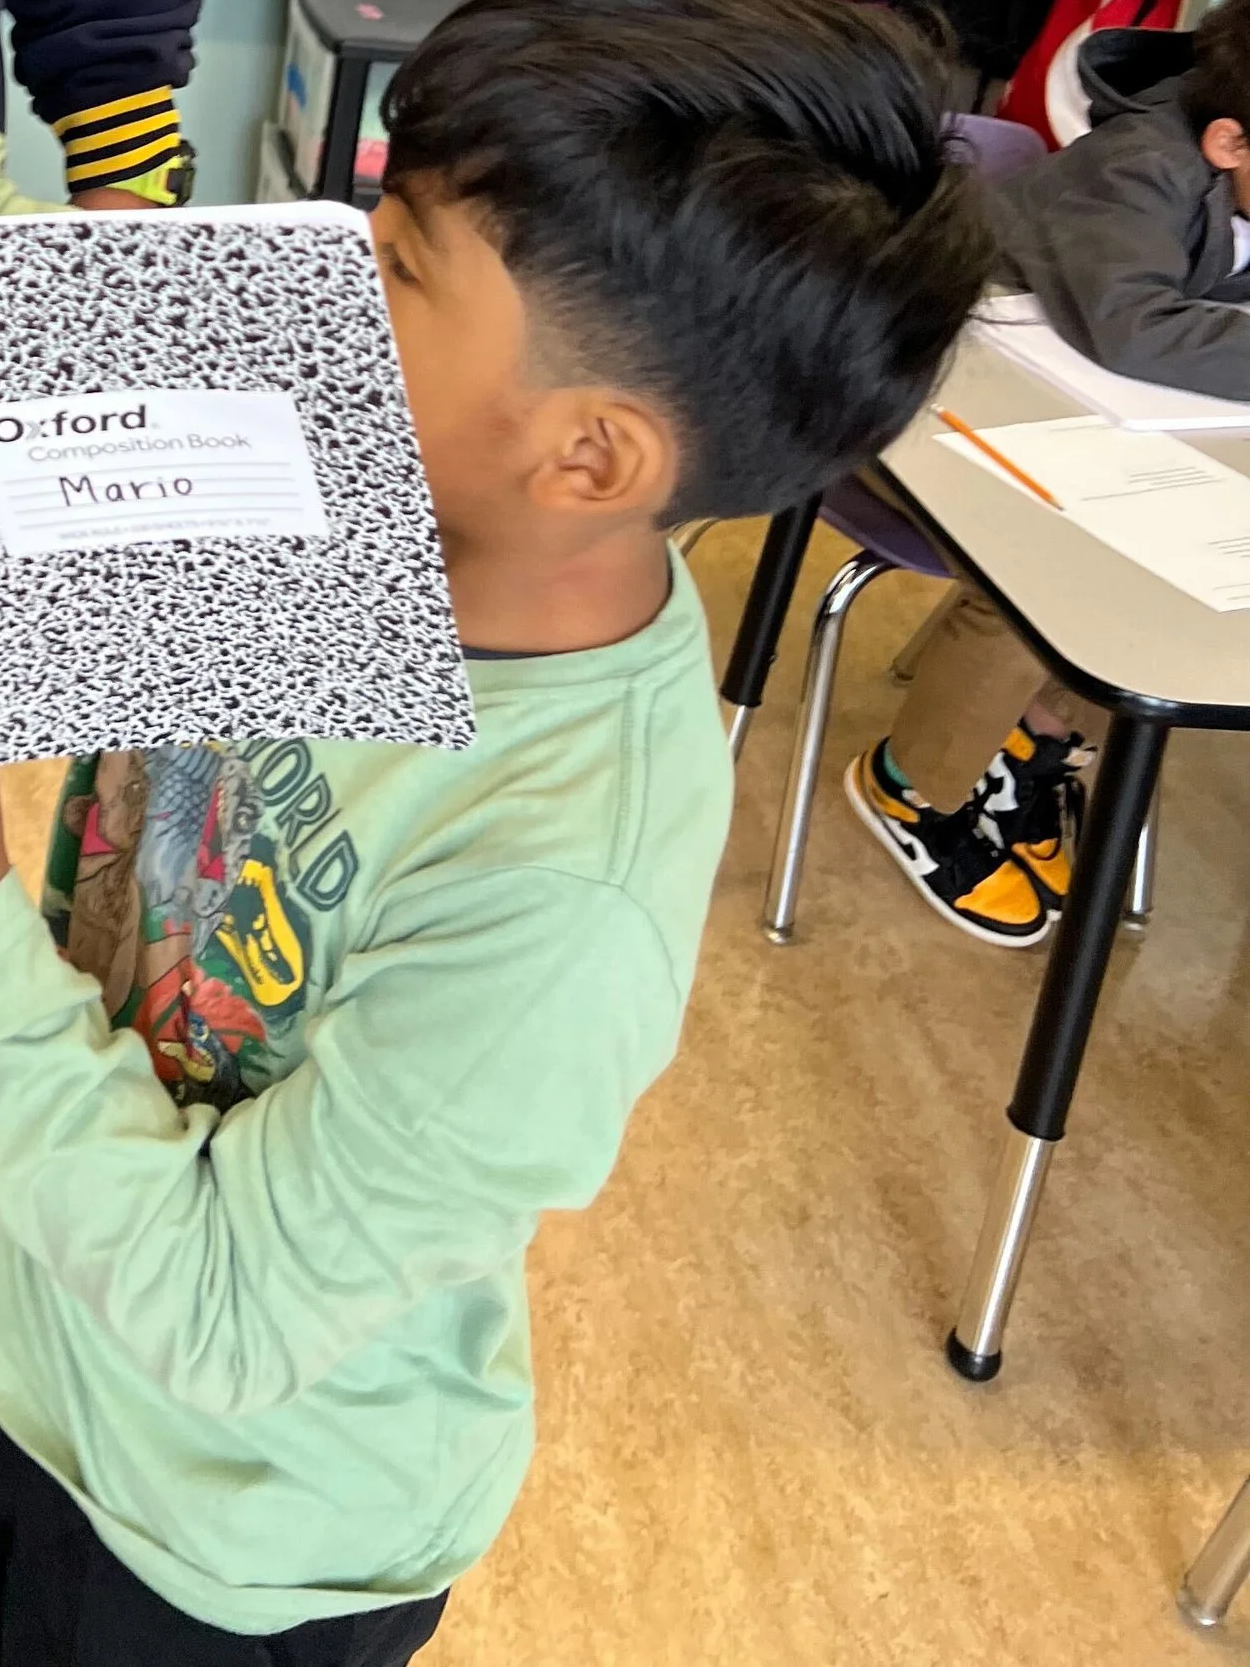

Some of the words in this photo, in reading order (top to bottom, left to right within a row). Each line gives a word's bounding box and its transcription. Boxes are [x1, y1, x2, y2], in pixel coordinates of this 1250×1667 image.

[27, 435, 185, 464] Composition
[187, 432, 251, 452] Book
[58, 474, 193, 507] Mario
[240, 737, 359, 912] ORLD
